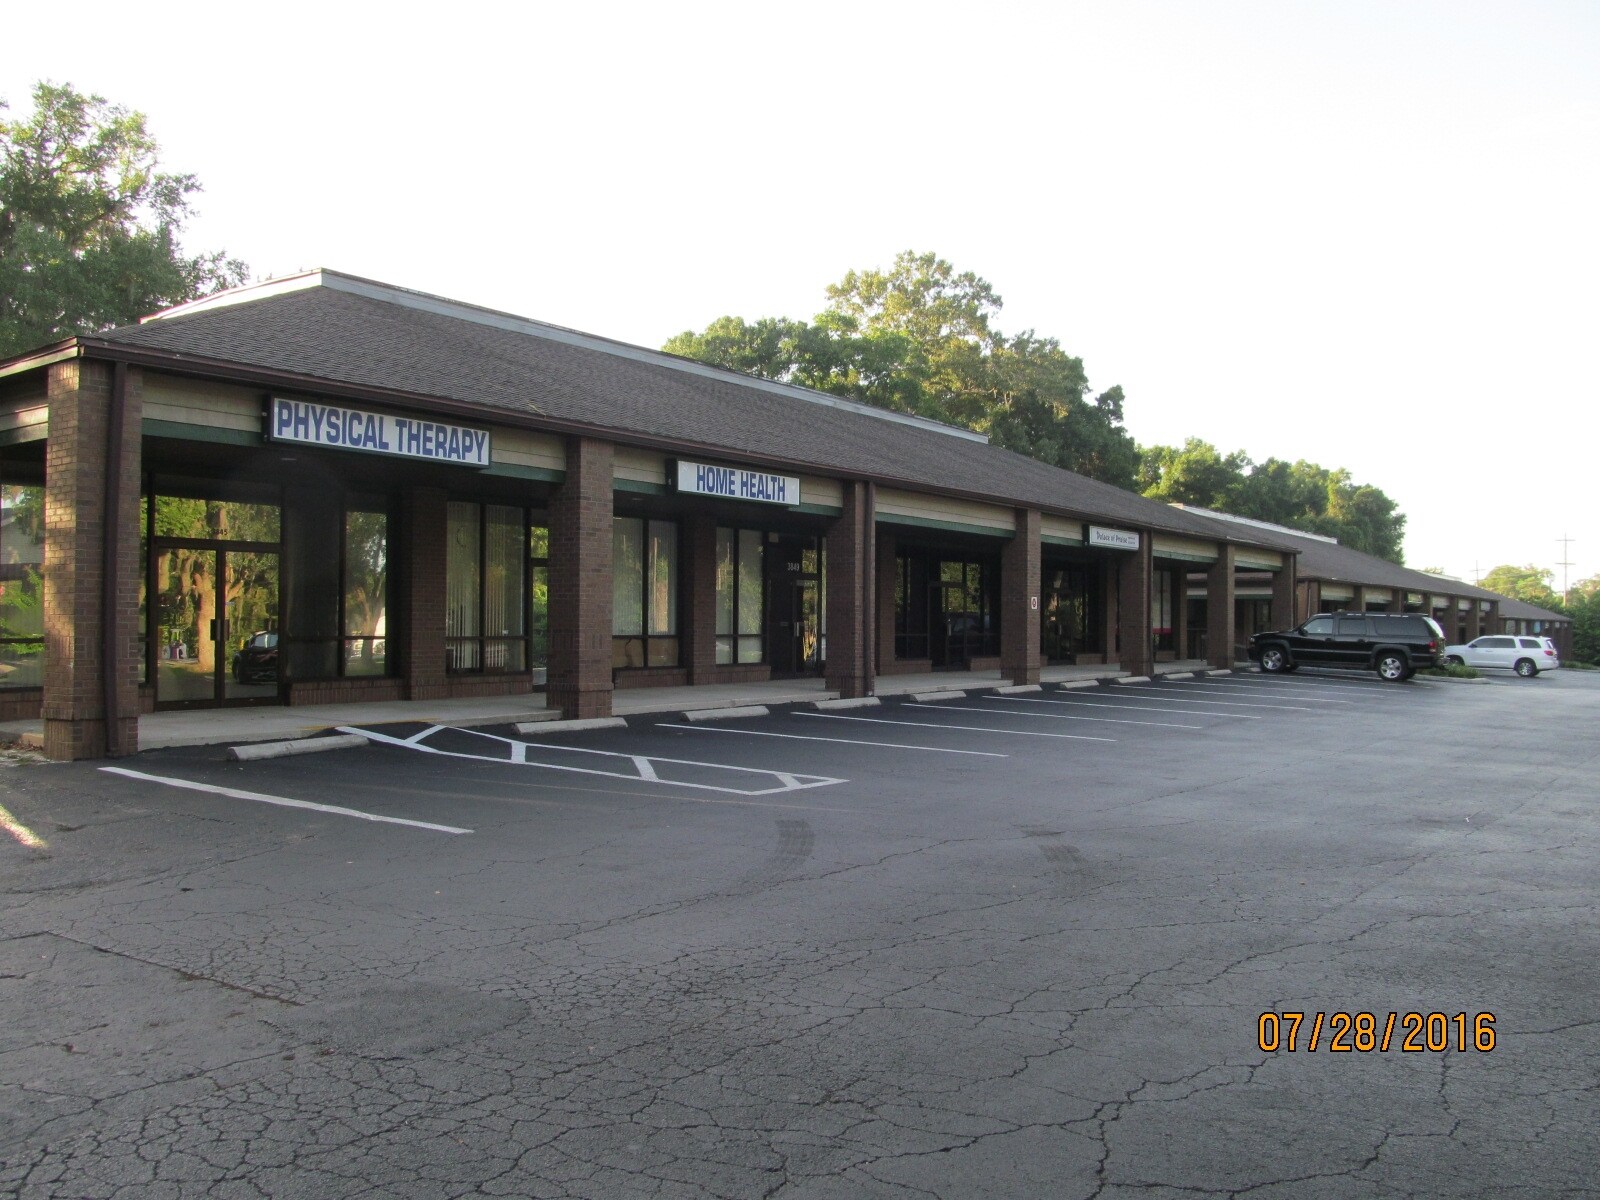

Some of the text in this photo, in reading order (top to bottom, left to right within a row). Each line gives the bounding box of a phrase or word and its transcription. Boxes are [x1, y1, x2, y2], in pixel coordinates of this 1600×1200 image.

[277, 401, 486, 463] PHYSICAL THERAPY
[696, 465, 786, 502] HOME HEALTH
